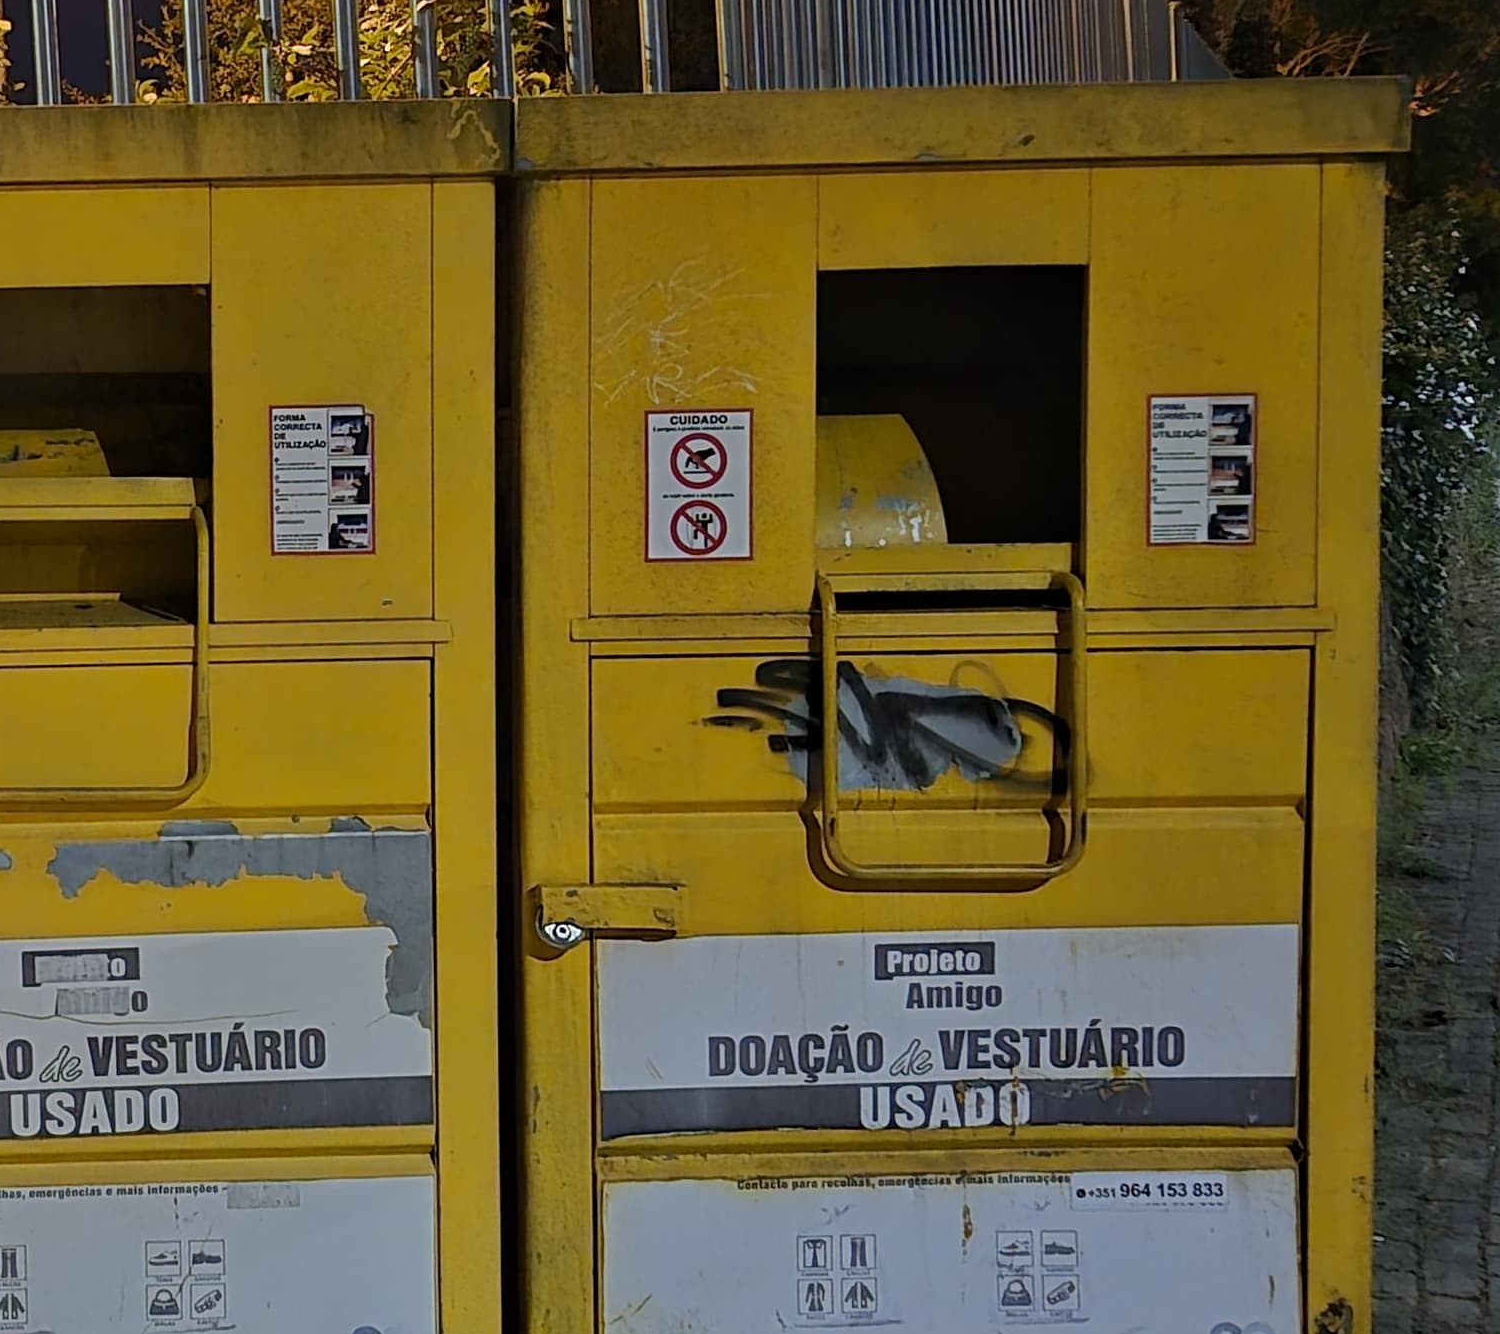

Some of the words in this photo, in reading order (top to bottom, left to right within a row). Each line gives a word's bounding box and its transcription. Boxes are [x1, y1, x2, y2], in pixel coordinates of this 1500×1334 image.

[274, 414, 306, 422] FORMA
[669, 414, 728, 425] CUIDADO
[274, 423, 322, 431] CORRECTA
[274, 432, 286, 440] DE
[274, 440, 326, 450] UTILIZAÇÃO
[886, 948, 981, 975] Projeto
[905, 982, 1003, 1011] Amigo
[39, 1045, 84, 1084] de
[86, 1022, 327, 1078] VESTUÁRIO
[708, 1024, 884, 1083] DOAÇÃO
[889, 1038, 934, 1077] de
[938, 1018, 1185, 1070] VESTUÁRIO
[9, 1087, 180, 1137] USADO
[859, 1082, 1030, 1130] USADO
[737, 1178, 788, 1190] Contacto
[791, 1179, 818, 1191] para
[877, 1175, 951, 1188] emergências
[966, 1173, 994, 1185] mais
[1119, 1183, 1151, 1198] 964
[1157, 1182, 1188, 1198] 153
[1192, 1182, 1224, 1198] 833
[28, 1187, 102, 1199] emergências
[105, 1187, 113, 1196] e
[116, 1185, 144, 1196] mais
[147, 1184, 219, 1197] informações
